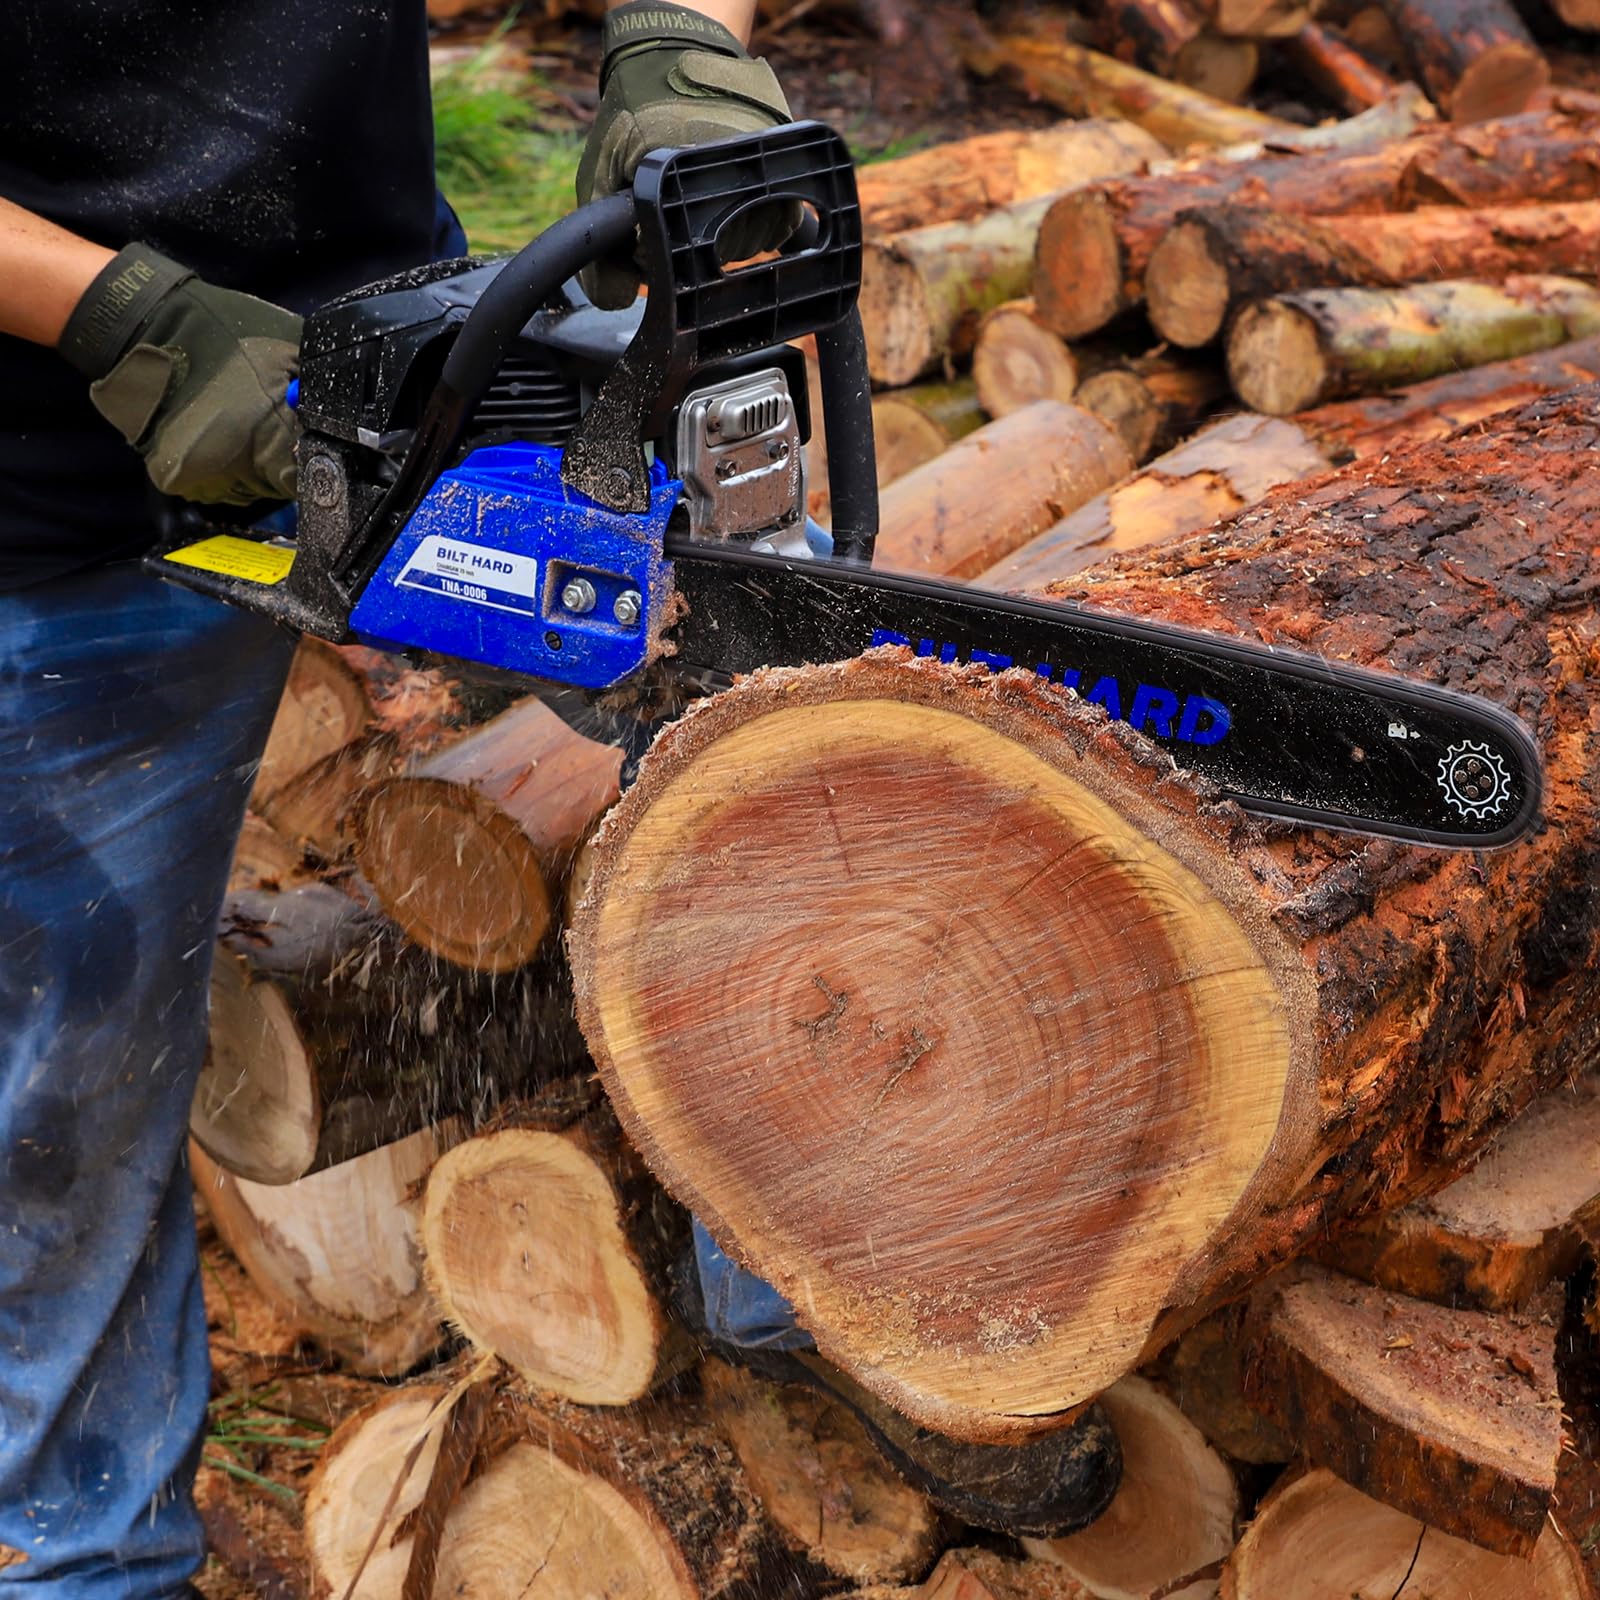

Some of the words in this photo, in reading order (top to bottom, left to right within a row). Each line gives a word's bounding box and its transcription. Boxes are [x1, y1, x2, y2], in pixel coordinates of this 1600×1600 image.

[437, 547, 468, 563] BILT
[471, 555, 513, 574] HARD
[440, 578, 487, 601] TNA-0006
